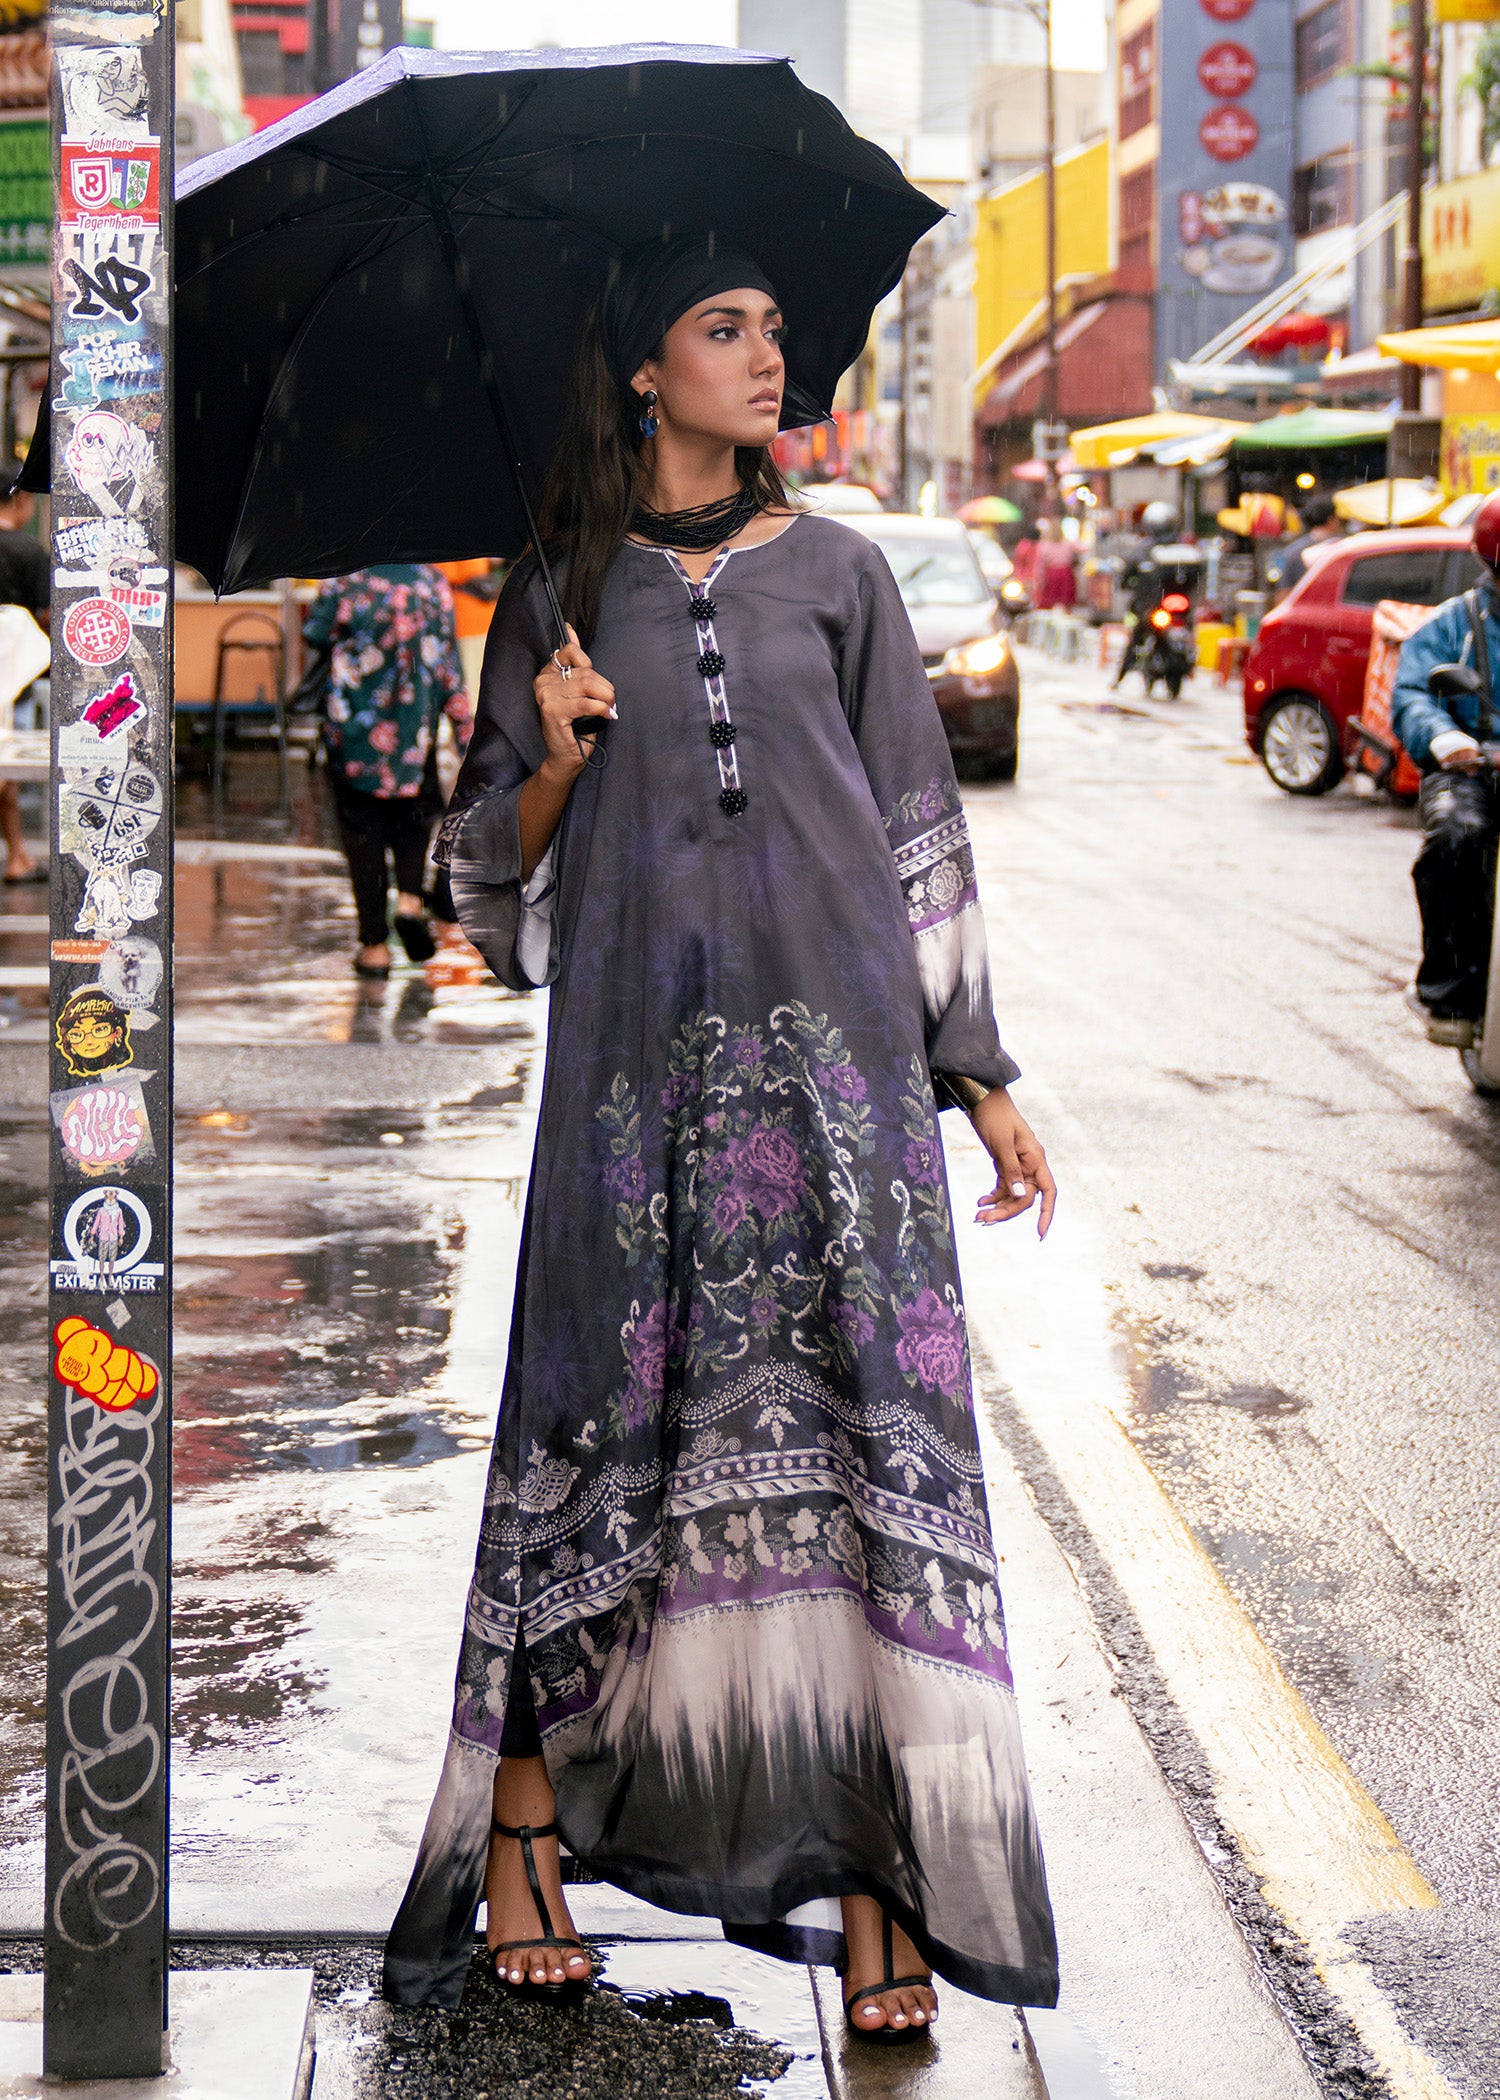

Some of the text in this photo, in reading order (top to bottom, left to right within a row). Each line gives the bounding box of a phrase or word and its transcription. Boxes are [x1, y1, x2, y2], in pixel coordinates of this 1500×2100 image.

[87, 138, 134, 150] Jahnfans
[79, 214, 141, 231] Tegernheim
[77, 329, 117, 349] POP
[67, 599, 99, 635] CODIGO
[98, 626, 129, 662] CODIGO
